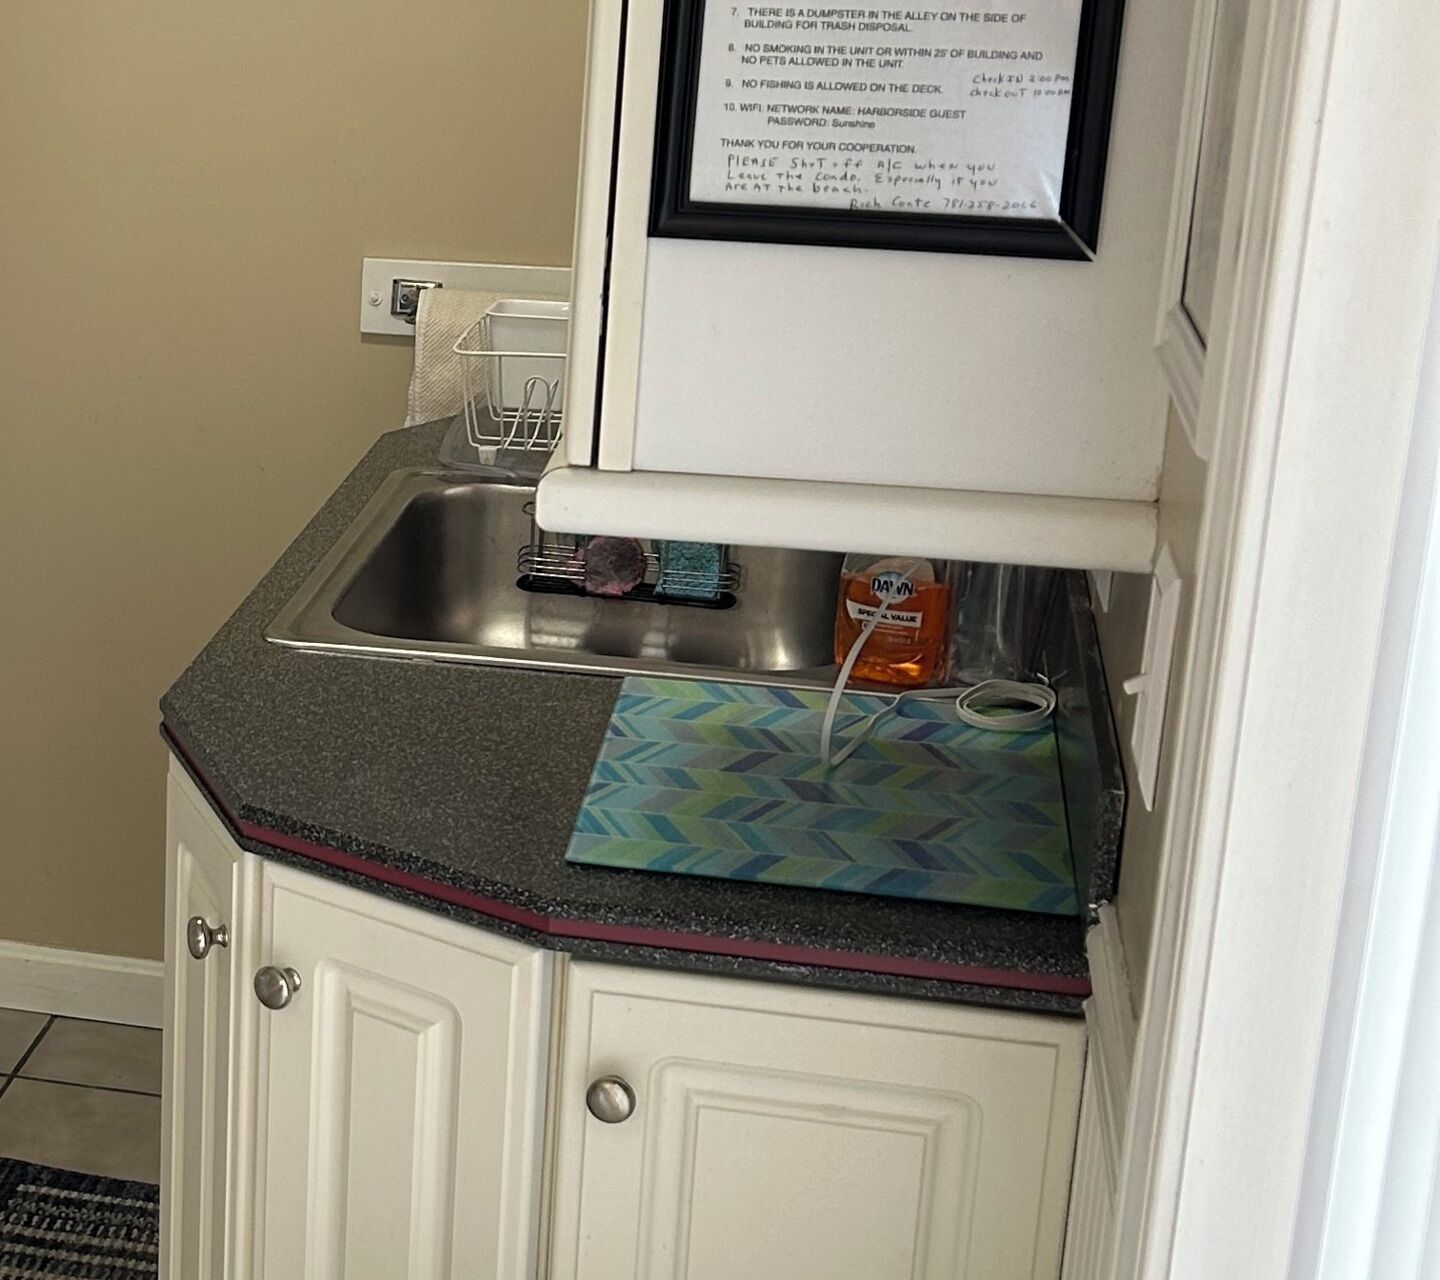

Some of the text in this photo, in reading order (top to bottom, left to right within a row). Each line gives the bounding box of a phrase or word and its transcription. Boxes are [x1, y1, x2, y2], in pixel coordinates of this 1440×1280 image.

[744, 20, 792, 29] BUILDING
[796, 20, 818, 30] FOR
[820, 21, 856, 31] TRASH
[741, 55, 757, 65] NO
[760, 56, 786, 66] PETS
[788, 57, 839, 67] ALLOWED
[842, 58, 852, 68] IN
[855, 58, 876, 68] THE
[742, 79, 758, 89] NO
[760, 80, 801, 90] FISHING
[804, 81, 814, 90] IS
[816, 82, 867, 92] ALLOWED
[870, 83, 886, 92] ON
[888, 83, 908, 93] THE
[767, 104, 819, 114] NETWORK
[858, 107, 926, 118] HARBORSIDE
[929, 109, 966, 119] GUEST
[832, 119, 875, 129] Sunshine
[720, 138, 754, 148] THANK
[758, 140, 779, 149] YOU
[782, 140, 804, 150] FOR
[806, 142, 836, 151] YOUR
[891, 613, 918, 623] VALUE
